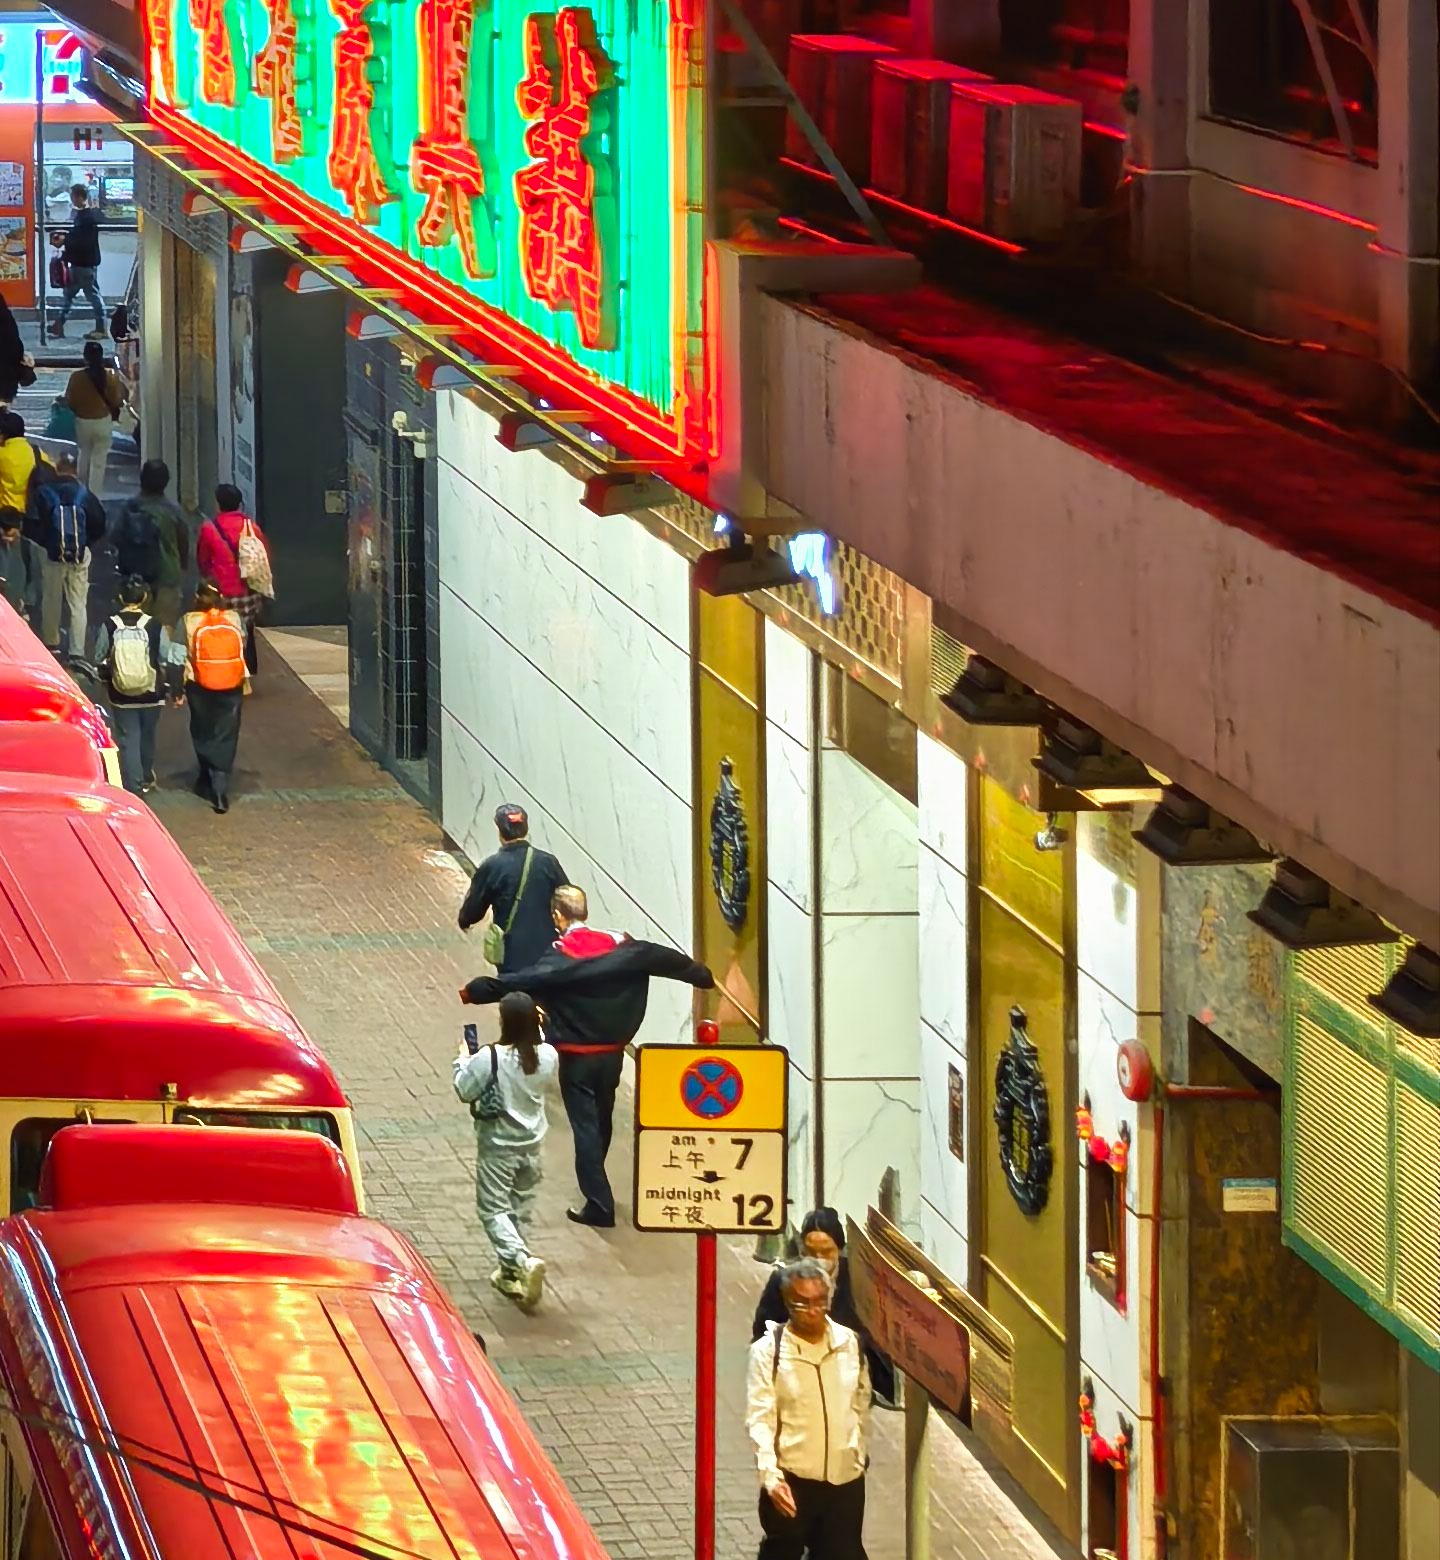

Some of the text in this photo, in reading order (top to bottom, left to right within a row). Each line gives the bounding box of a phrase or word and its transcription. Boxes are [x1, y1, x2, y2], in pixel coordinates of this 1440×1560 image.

[671, 1135, 697, 1146] am
[662, 1150, 705, 1169] 上午
[730, 1138, 753, 1170] 7
[645, 1187, 721, 1203] midnight
[662, 1205, 705, 1224] 午夜
[732, 1194, 774, 1226] 12
